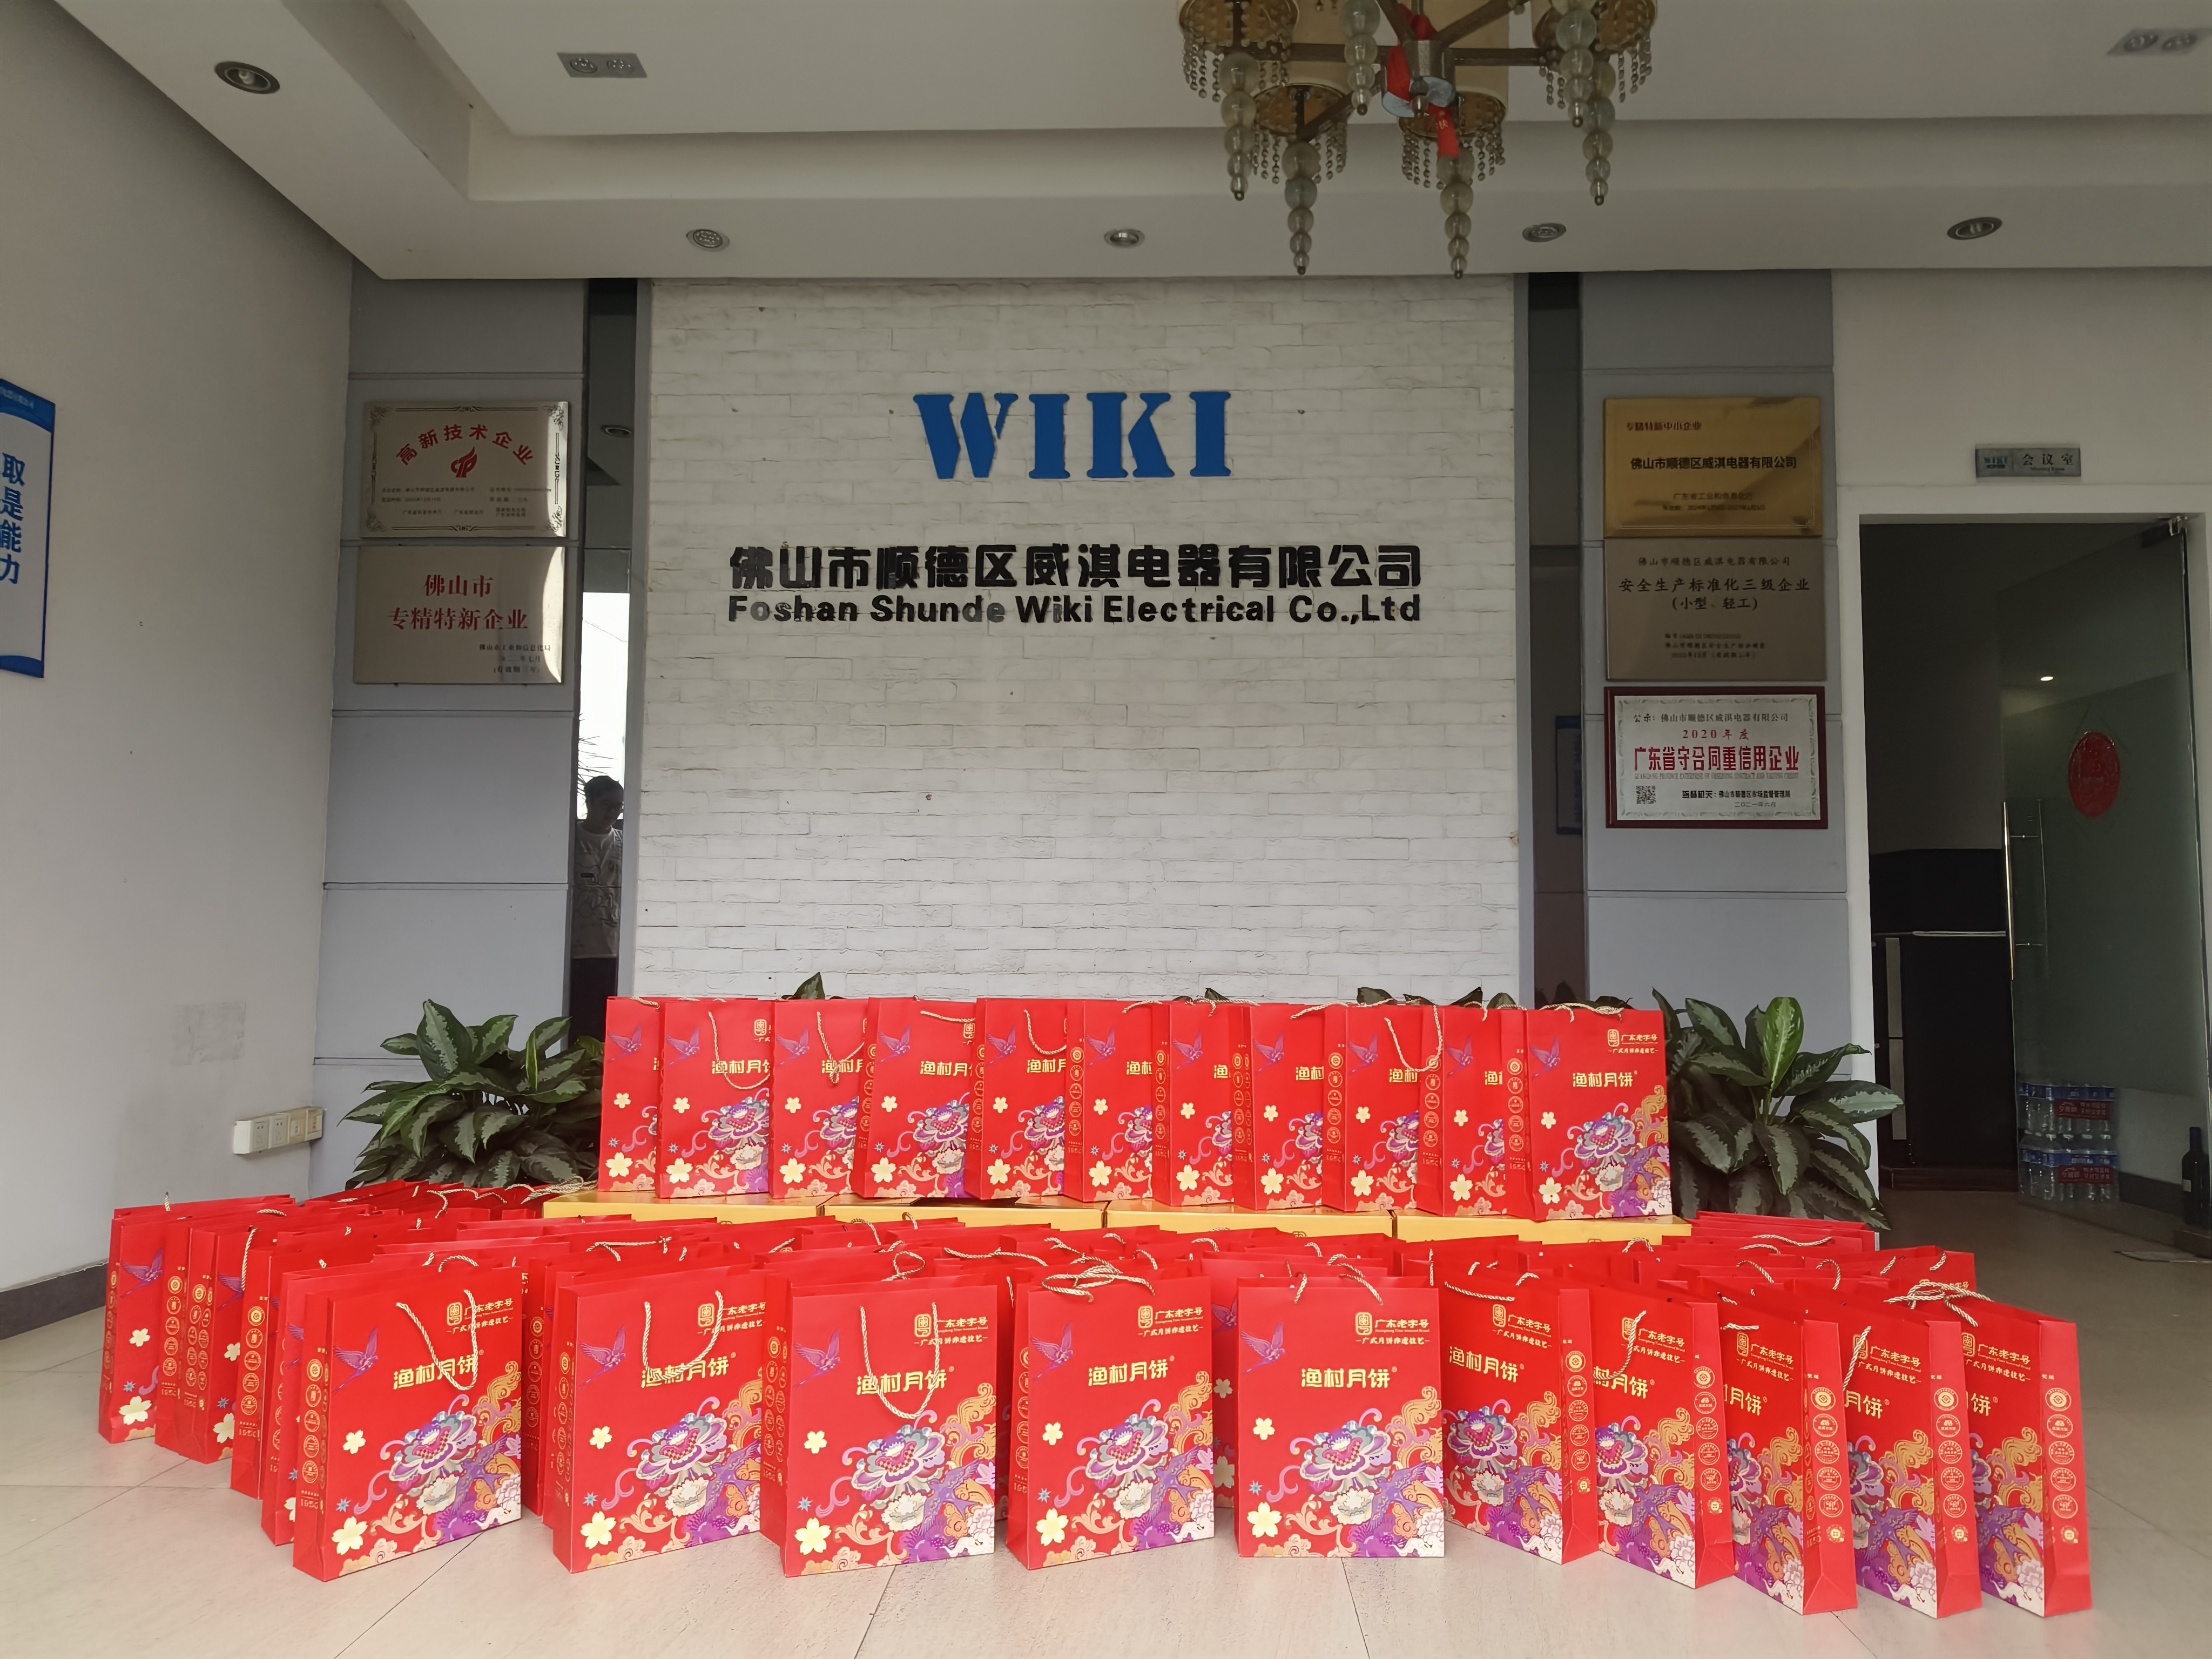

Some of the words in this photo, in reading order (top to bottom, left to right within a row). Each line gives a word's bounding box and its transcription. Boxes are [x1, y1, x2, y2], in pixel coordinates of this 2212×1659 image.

[396, 424, 533, 466] 高新技术企业
[913, 391, 1231, 479] WIKI
[1630, 456, 1797, 470] 佛山市顺德区威淇电器有限公司
[1984, 456, 2008, 464] WIKI
[2022, 453, 2073, 466] 会议室
[0, 451, 25, 585] 取是能力
[730, 543, 1421, 590] 佛山市顺德区威淇电器有限公司
[424, 575, 494, 597] 佛山市
[1618, 577, 1810, 593] 安全生产标准化三级企业
[387, 607, 528, 631] 专精特新企业
[729, 595, 858, 622] Foshan
[870, 595, 1006, 623] Shunde
[1015, 595, 1092, 623] Wiki
[1103, 595, 1274, 623] Electrical
[1289, 594, 1421, 625] Co.,Ltd
[1682, 729, 1750, 740] 2020年度
[1634, 746, 1799, 771] 广东省守合同重信用企业
[920, 1061, 973, 1075] 渔村月
[1295, 1066, 1324, 1081] 渔村
[1388, 1068, 1418, 1083] 渔村
[1572, 1072, 1634, 1088] 渔村月饼
[1155, 1307, 1203, 1320] 广东老字号
[1374, 1319, 1429, 1328] 广东老字号
[1508, 1314, 1551, 1333] 广东老字号
[1638, 1328, 1685, 1347] 广东老字号
[1449, 1346, 1519, 1383] 渔村月饼
[1627, 1344, 1681, 1364] 式月饼非遗技艺
[1750, 1344, 1794, 1365] 广东老字号
[1870, 1346, 1921, 1368] 广东老字号
[1978, 1344, 2031, 1366] 广东老字号
[393, 1354, 476, 1390] 渔村月饼
[641, 1356, 729, 1388] 渔村月饼
[857, 1369, 947, 1395] 渔村月饼
[1088, 1359, 1168, 1386] 渔村月饼
[1301, 1368, 1391, 1388] 渔村月饼
[1844, 1389, 1883, 1419] 月饼
